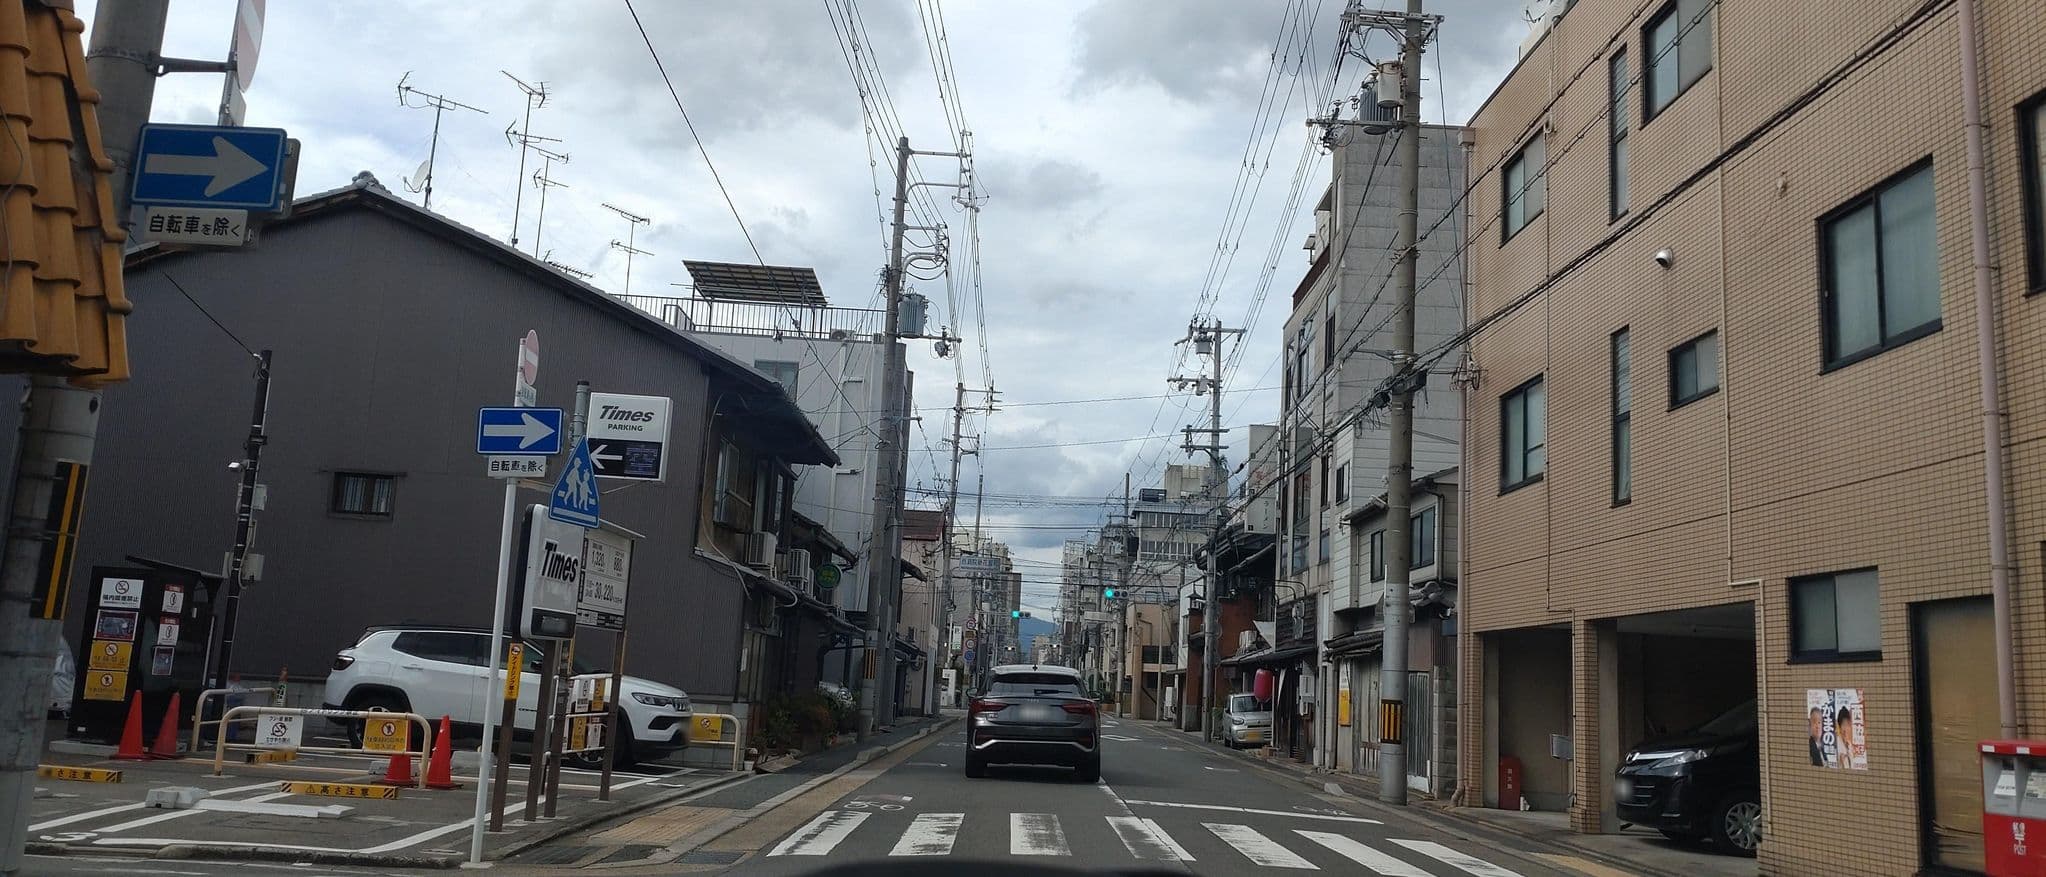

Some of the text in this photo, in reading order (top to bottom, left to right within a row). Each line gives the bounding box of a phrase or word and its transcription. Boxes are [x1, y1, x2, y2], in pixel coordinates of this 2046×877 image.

[149, 214, 241, 237] 自転車を除く
[599, 405, 655, 423] Times
[607, 423, 643, 432] PARKING
[490, 459, 544, 472] 自転車を除く
[541, 541, 578, 583] Times
[320, 785, 370, 797] 高さ注意
